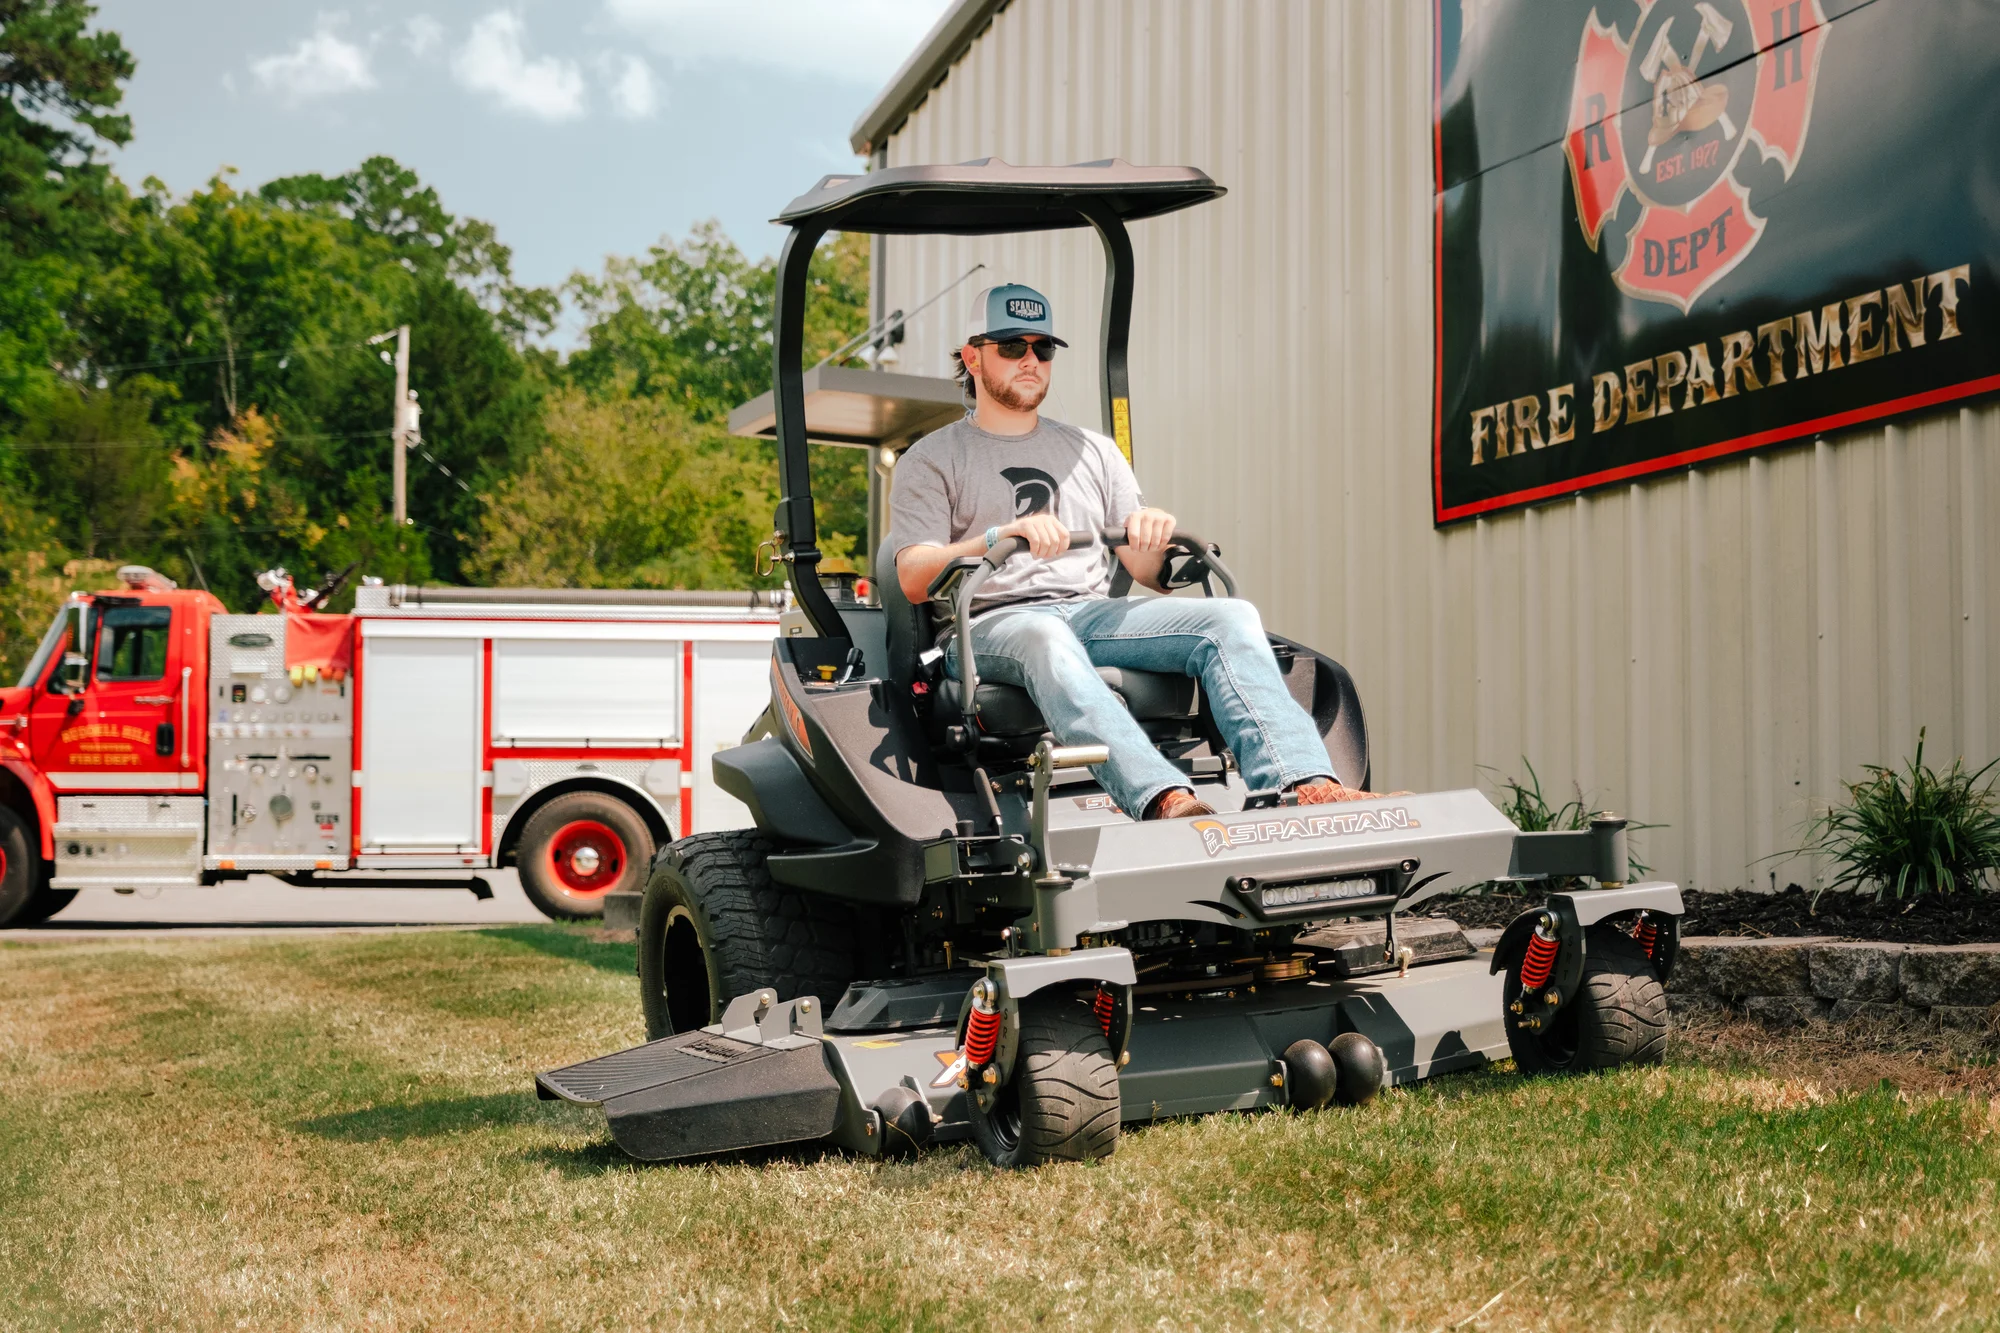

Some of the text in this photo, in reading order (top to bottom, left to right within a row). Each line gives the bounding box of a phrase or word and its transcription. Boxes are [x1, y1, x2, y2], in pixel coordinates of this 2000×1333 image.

[1771, 2, 1803, 91] H
[1583, 92, 1612, 171] R
[1656, 140, 1719, 183] EST. 1977
[1643, 206, 1733, 277] DEPT
[1009, 300, 1043, 316] SPARTAN
[1470, 264, 1970, 466] FIRE DEPARTMENT
[69, 753, 102, 765] FIRE
[1228, 809, 1408, 844] SPARTAN
[1001, 1007, 1009, 1057] SRT
